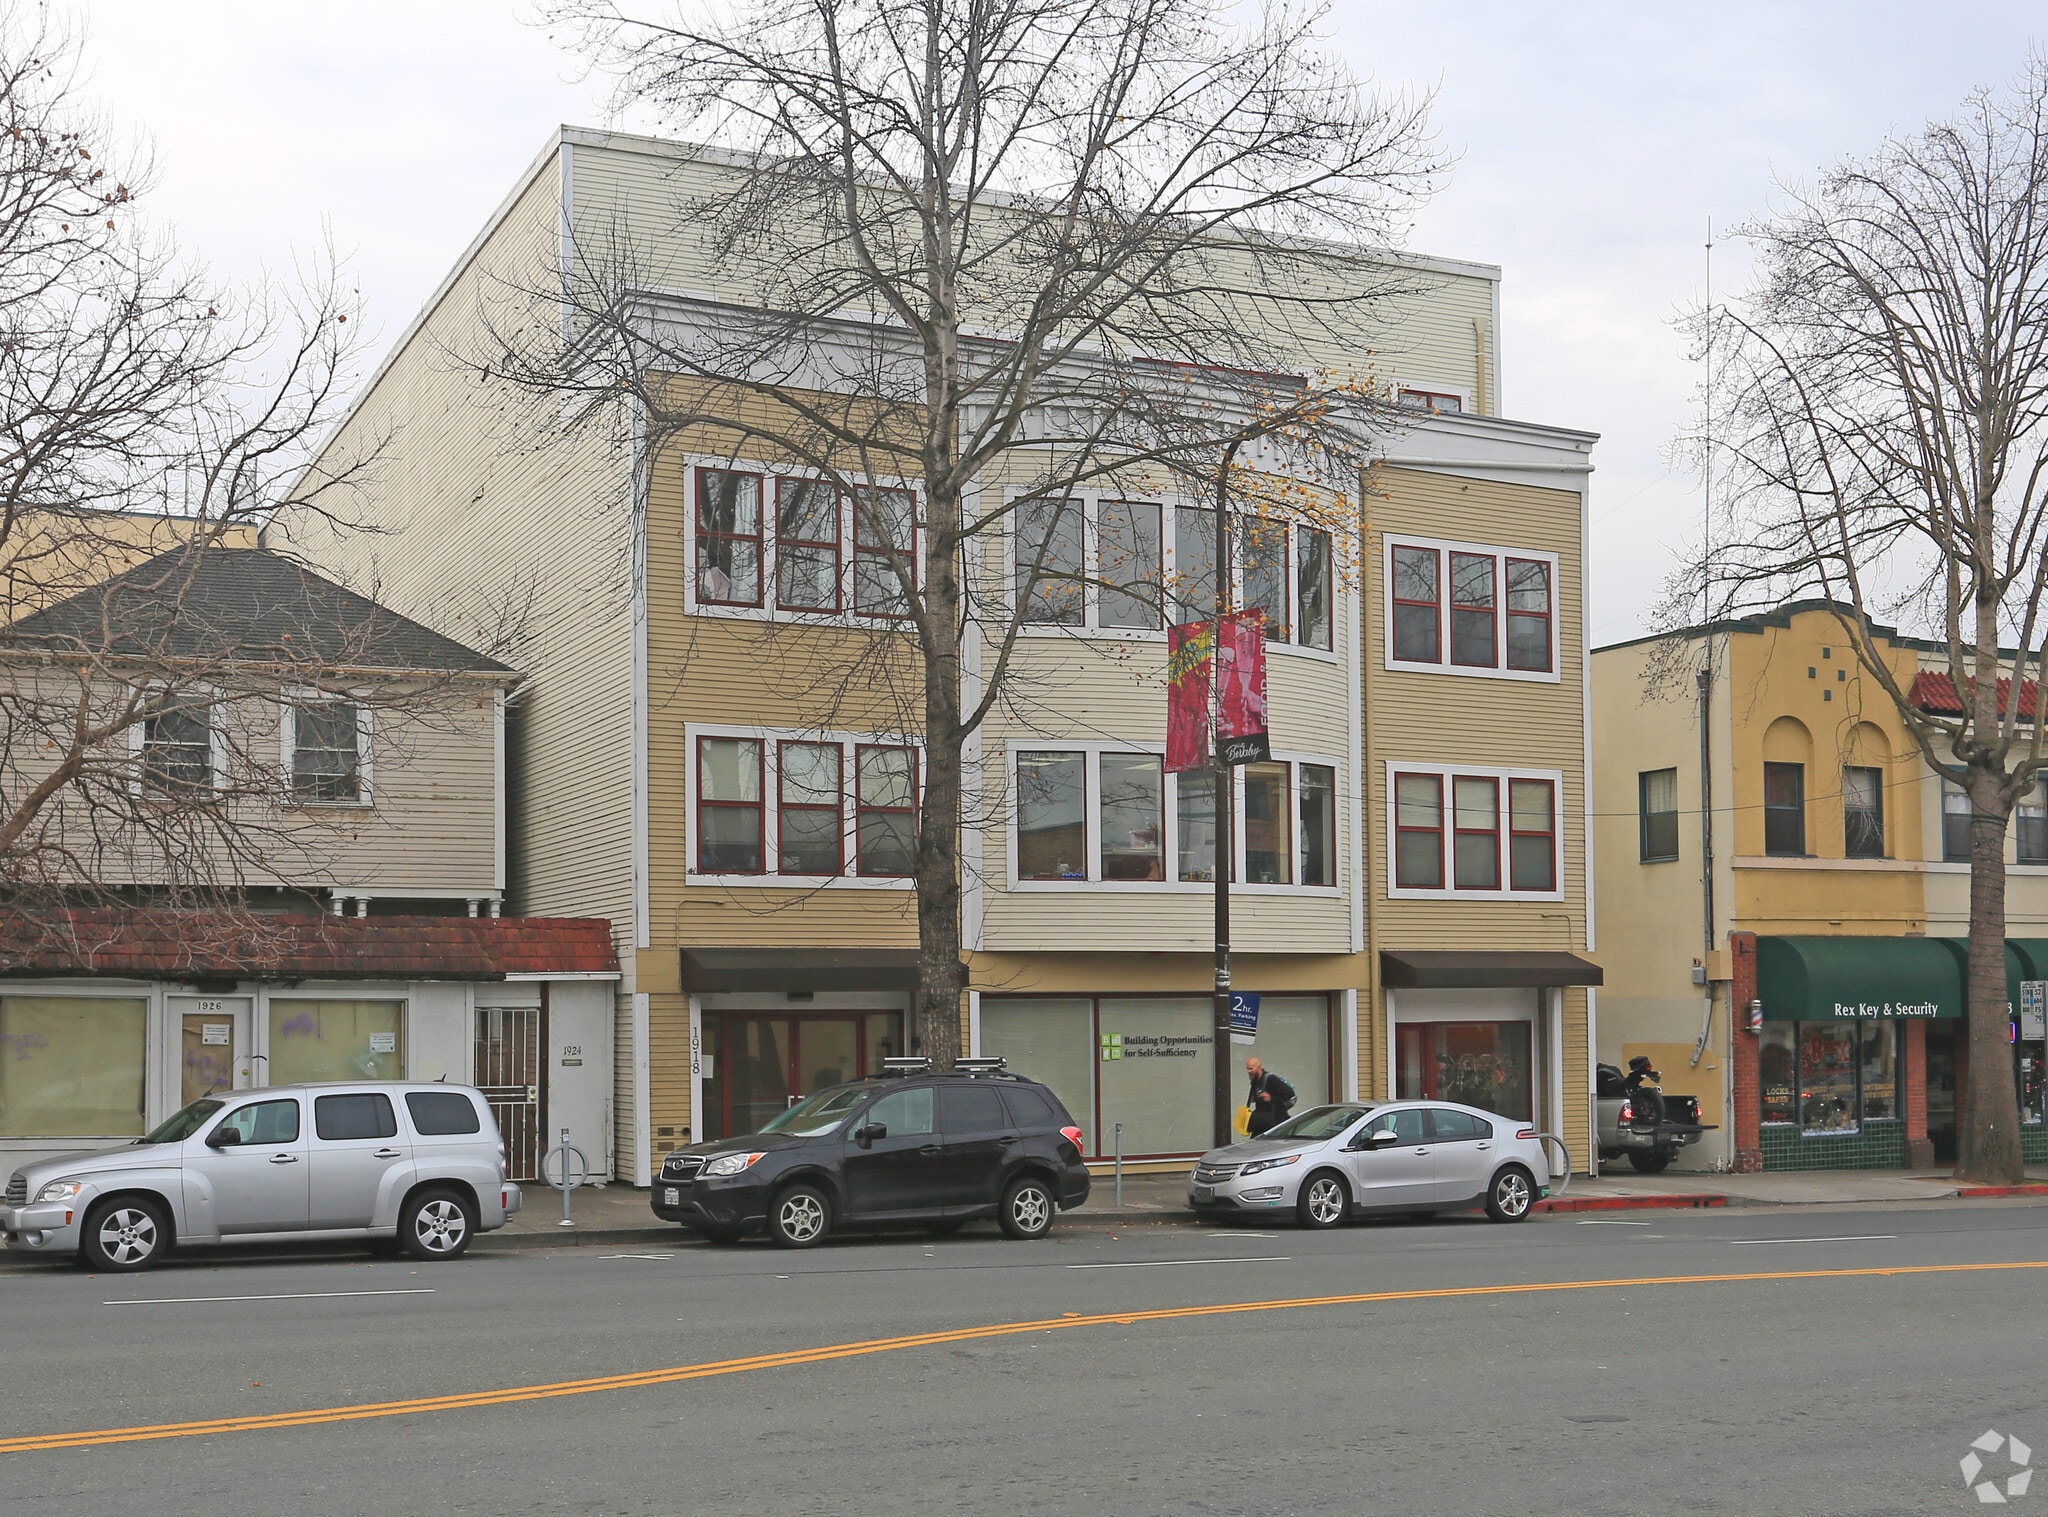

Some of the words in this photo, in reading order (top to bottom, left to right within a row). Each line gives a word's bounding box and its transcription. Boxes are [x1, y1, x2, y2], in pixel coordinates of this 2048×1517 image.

[1260, 679, 1268, 726] FOOD
[198, 1001, 222, 1010] 1926
[1835, 1003, 1855, 1016] Rex
[1859, 1003, 1879, 1019] Key
[1883, 1003, 1892, 1015] &
[1896, 1001, 1938, 1018] Security
[1238, 1013, 1256, 1021] Parking
[1124, 1036, 1159, 1046] Building
[1160, 1035, 1213, 1046] Opportunities
[563, 1045, 582, 1056] 1924
[692, 1026, 700, 1074] 1918
[1124, 1049, 1136, 1057] for
[1138, 1048, 1197, 1058] Self-Sufficiency
[1766, 1087, 1789, 1096] LOCKS
